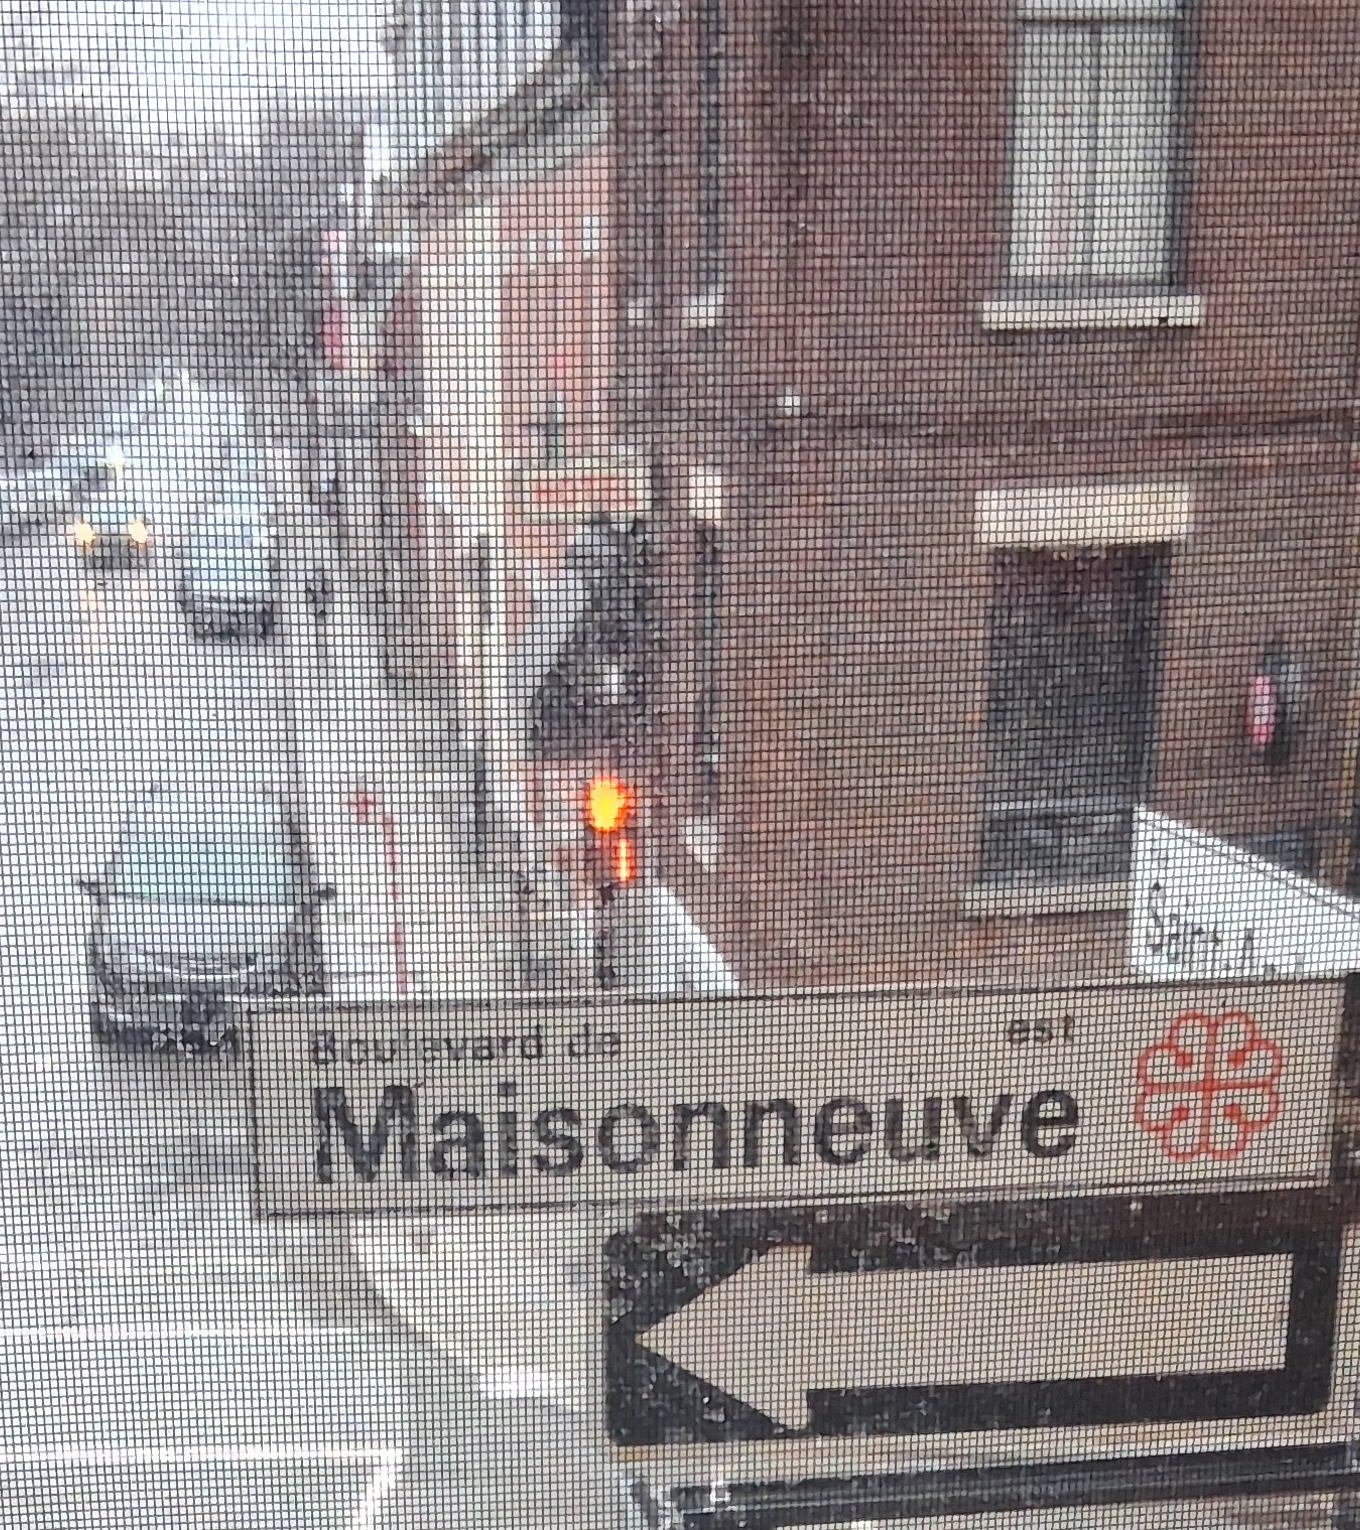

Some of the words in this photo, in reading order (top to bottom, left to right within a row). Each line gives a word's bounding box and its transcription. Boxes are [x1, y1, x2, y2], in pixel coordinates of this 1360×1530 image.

[312, 1025, 541, 1065] Boulevard
[568, 1022, 621, 1058] de
[1008, 1014, 1076, 1046] est
[312, 1080, 1079, 1184] Maisonneuve
